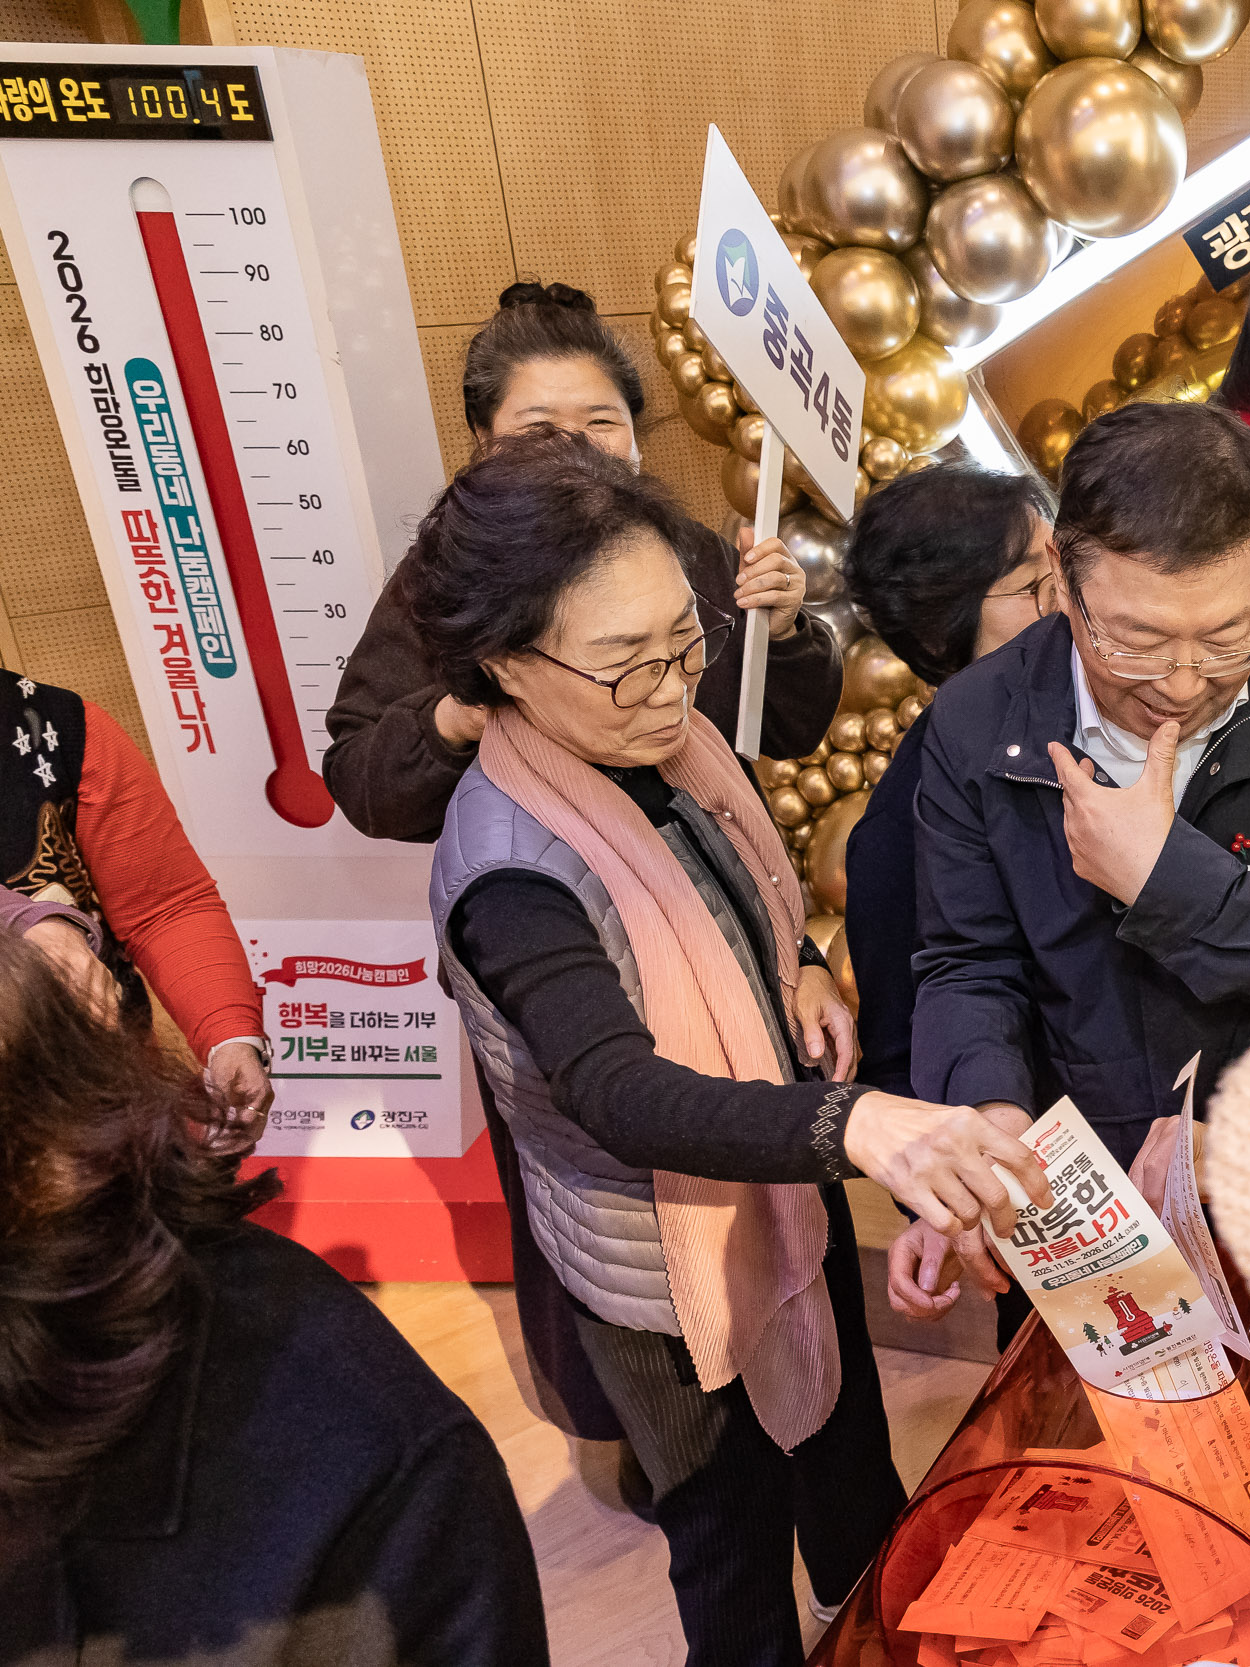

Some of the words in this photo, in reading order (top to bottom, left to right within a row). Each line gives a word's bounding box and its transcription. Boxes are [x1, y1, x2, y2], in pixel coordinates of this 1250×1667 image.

[59, 77, 111, 122] 온도
[229, 207, 266, 225] 100
[244, 264, 270, 282] 90
[260, 325, 284, 342] 80
[763, 282, 853, 463] 중곡4동
[272, 383, 297, 400] 70
[286, 439, 310, 456] 60
[47, 230, 100, 354] 2026
[83, 363, 142, 492] 희망온돌
[121, 508, 179, 614] 따뜻한
[153, 623, 216, 754] 겨울나기
[299, 494, 323, 511] 50
[132, 379, 193, 507] 우리동네
[169, 516, 232, 665] 나눔캠페인
[312, 550, 335, 566] 40
[324, 604, 347, 619] 30
[336, 657, 351, 671] 2
[295, 961, 410, 984] 희망2026나눔캠페인
[278, 1002, 345, 1029] 행복을
[350, 1011, 399, 1029] 더하는
[404, 1011, 436, 1028] 기부
[280, 1036, 346, 1062] 기부로
[351, 1045, 400, 1062] 바꾸는
[404, 1045, 437, 1063] 서울
[270, 1110, 325, 1124] 랑의열매
[380, 1111, 429, 1123] 광진구
[1050, 1151, 1094, 1196] 망온돌
[1010, 1170, 1114, 1248] 따뜻한
[1020, 1199, 1130, 1266] 겨울나기
[1031, 1267, 1055, 1277] 2025.
[1081, 1246, 1104, 1260] 2026.
[1102, 1239, 1116, 1250] 02.
[1084, 1571, 1138, 1600] 희망온돌
[1134, 1593, 1171, 1615] 2026
